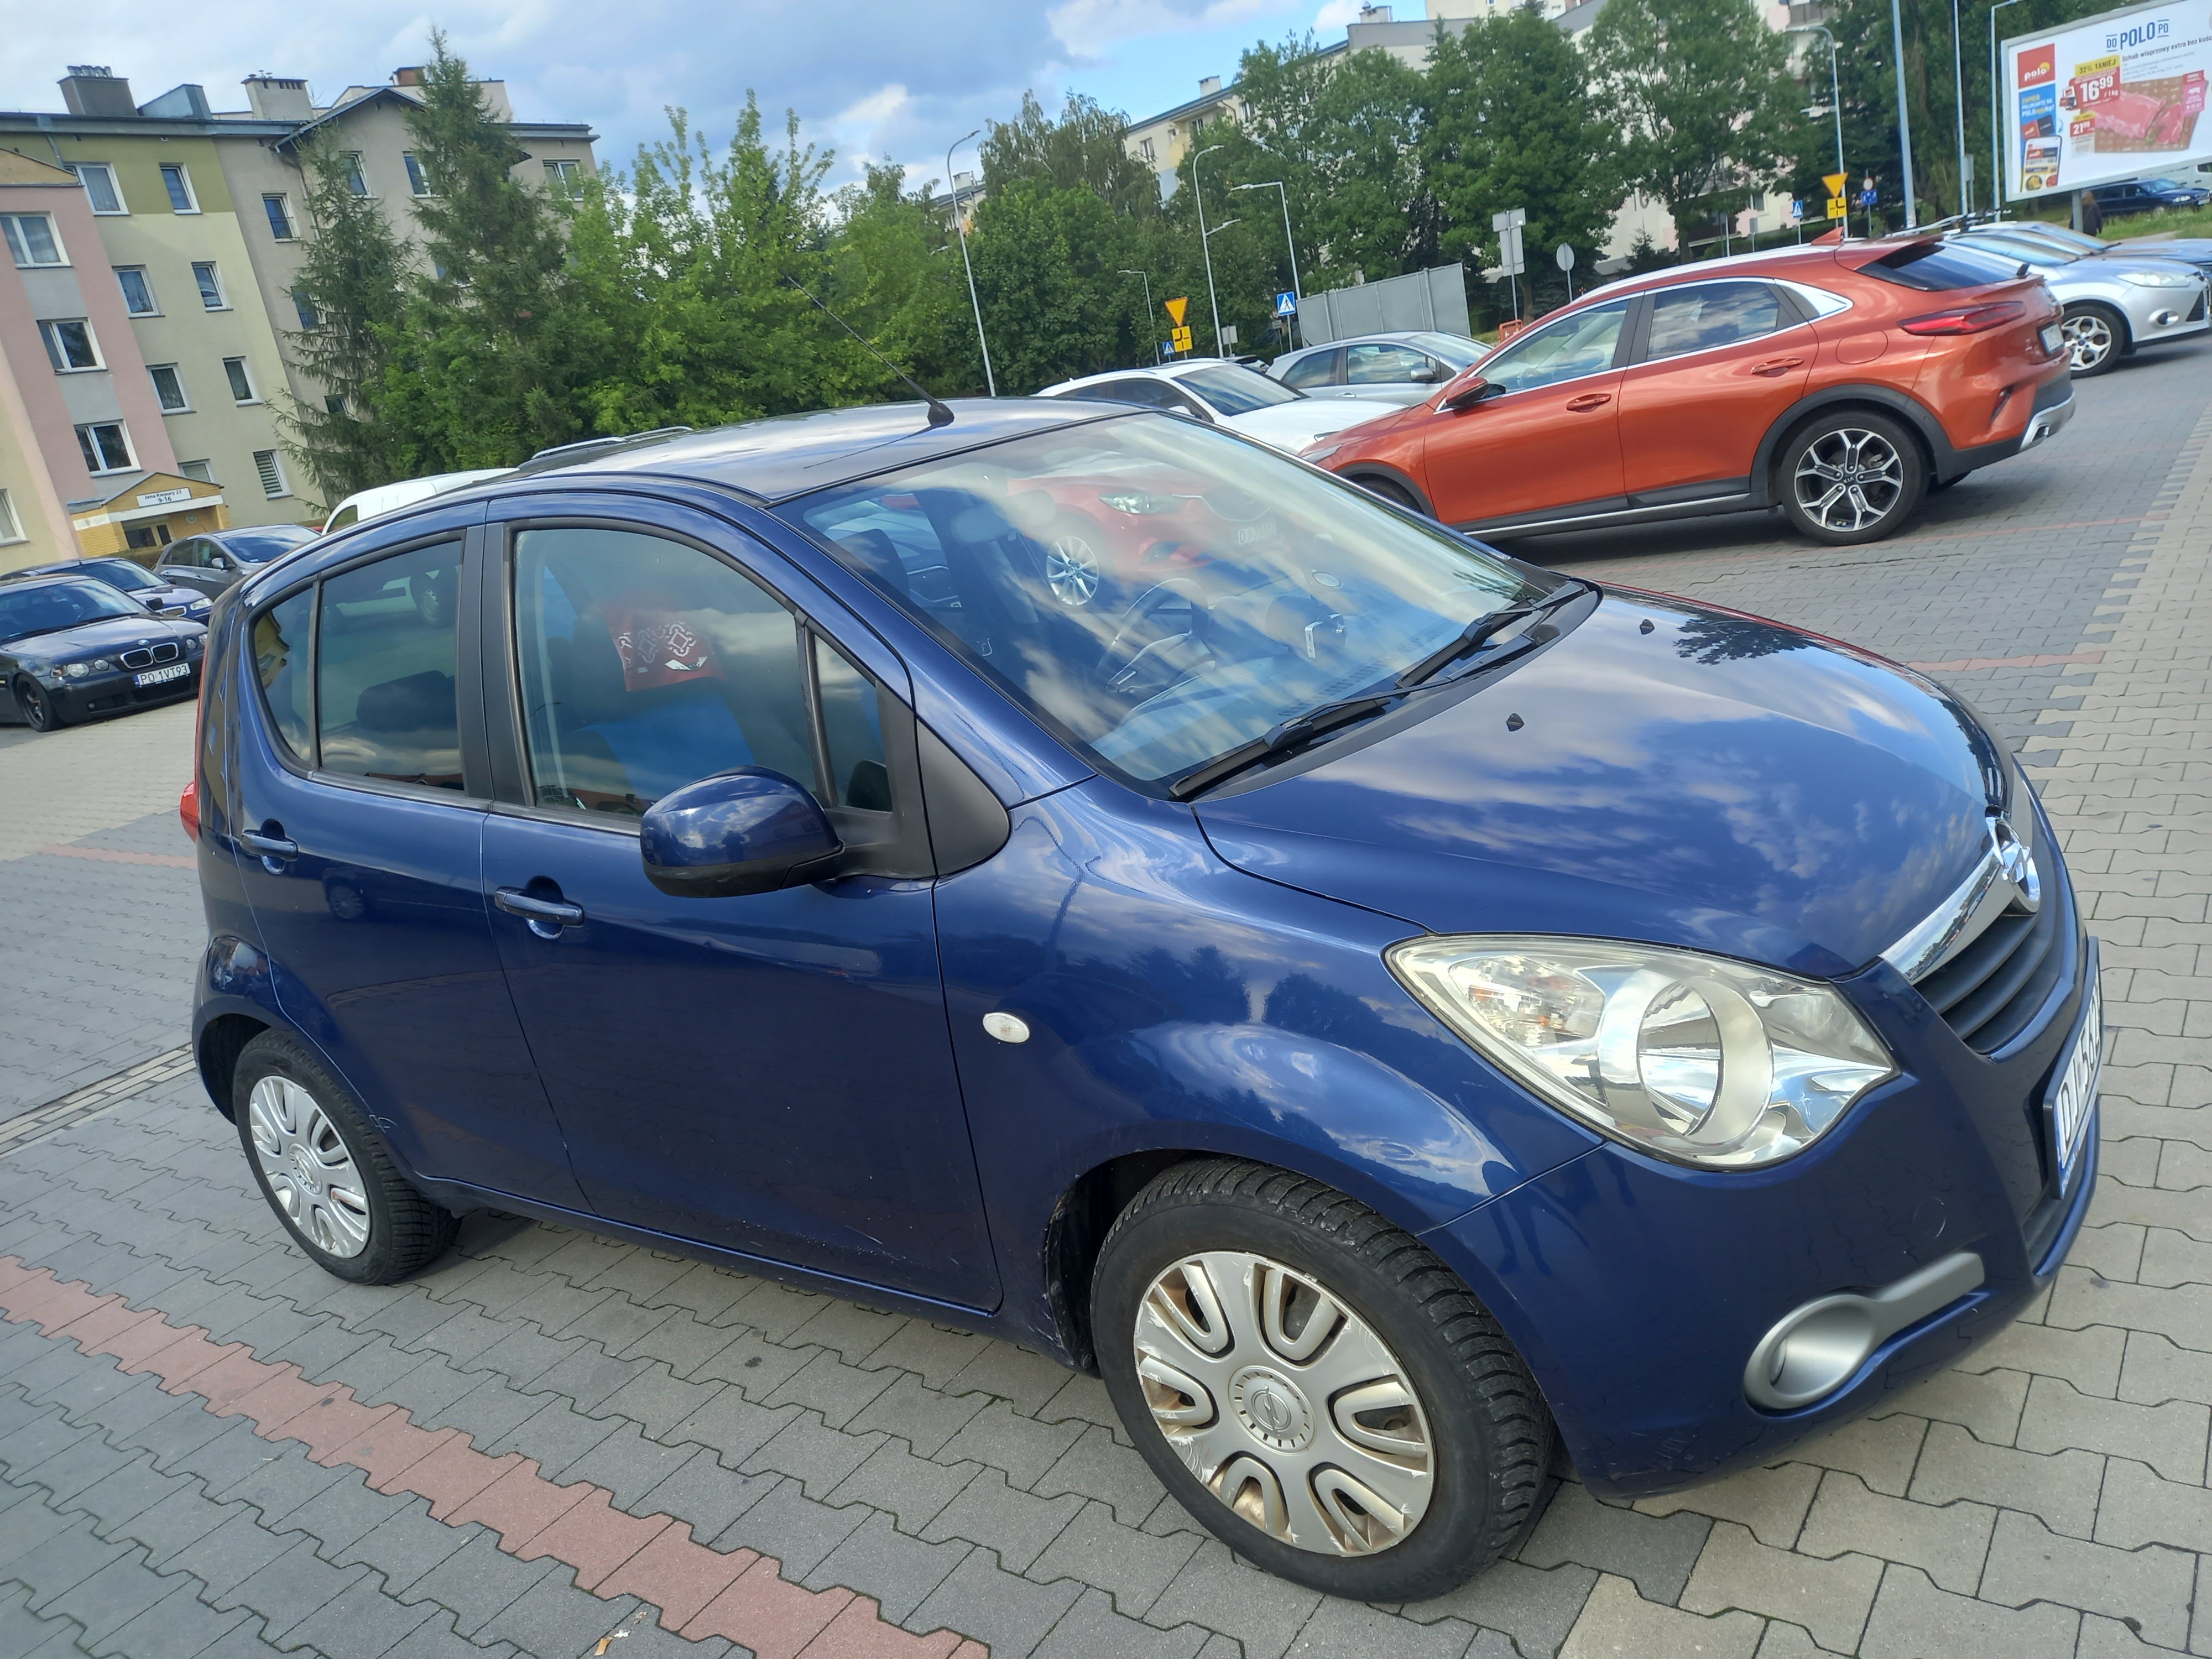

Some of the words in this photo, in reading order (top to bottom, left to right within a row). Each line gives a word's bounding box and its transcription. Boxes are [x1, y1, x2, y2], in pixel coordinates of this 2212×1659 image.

[2106, 38, 2117, 49] DO
[2120, 22, 2156, 50] POLO
[2158, 23, 2169, 34] PO
[2122, 53, 2139, 62] Schab
[2171, 42, 2186, 51] extra
[2187, 38, 2198, 46] bez
[2024, 67, 2047, 82] polo
[2095, 59, 2116, 70] TANIEJ
[140, 673, 155, 684] PO
[158, 665, 187, 680] 1VT93
[2060, 1058, 2079, 1153] DJ
